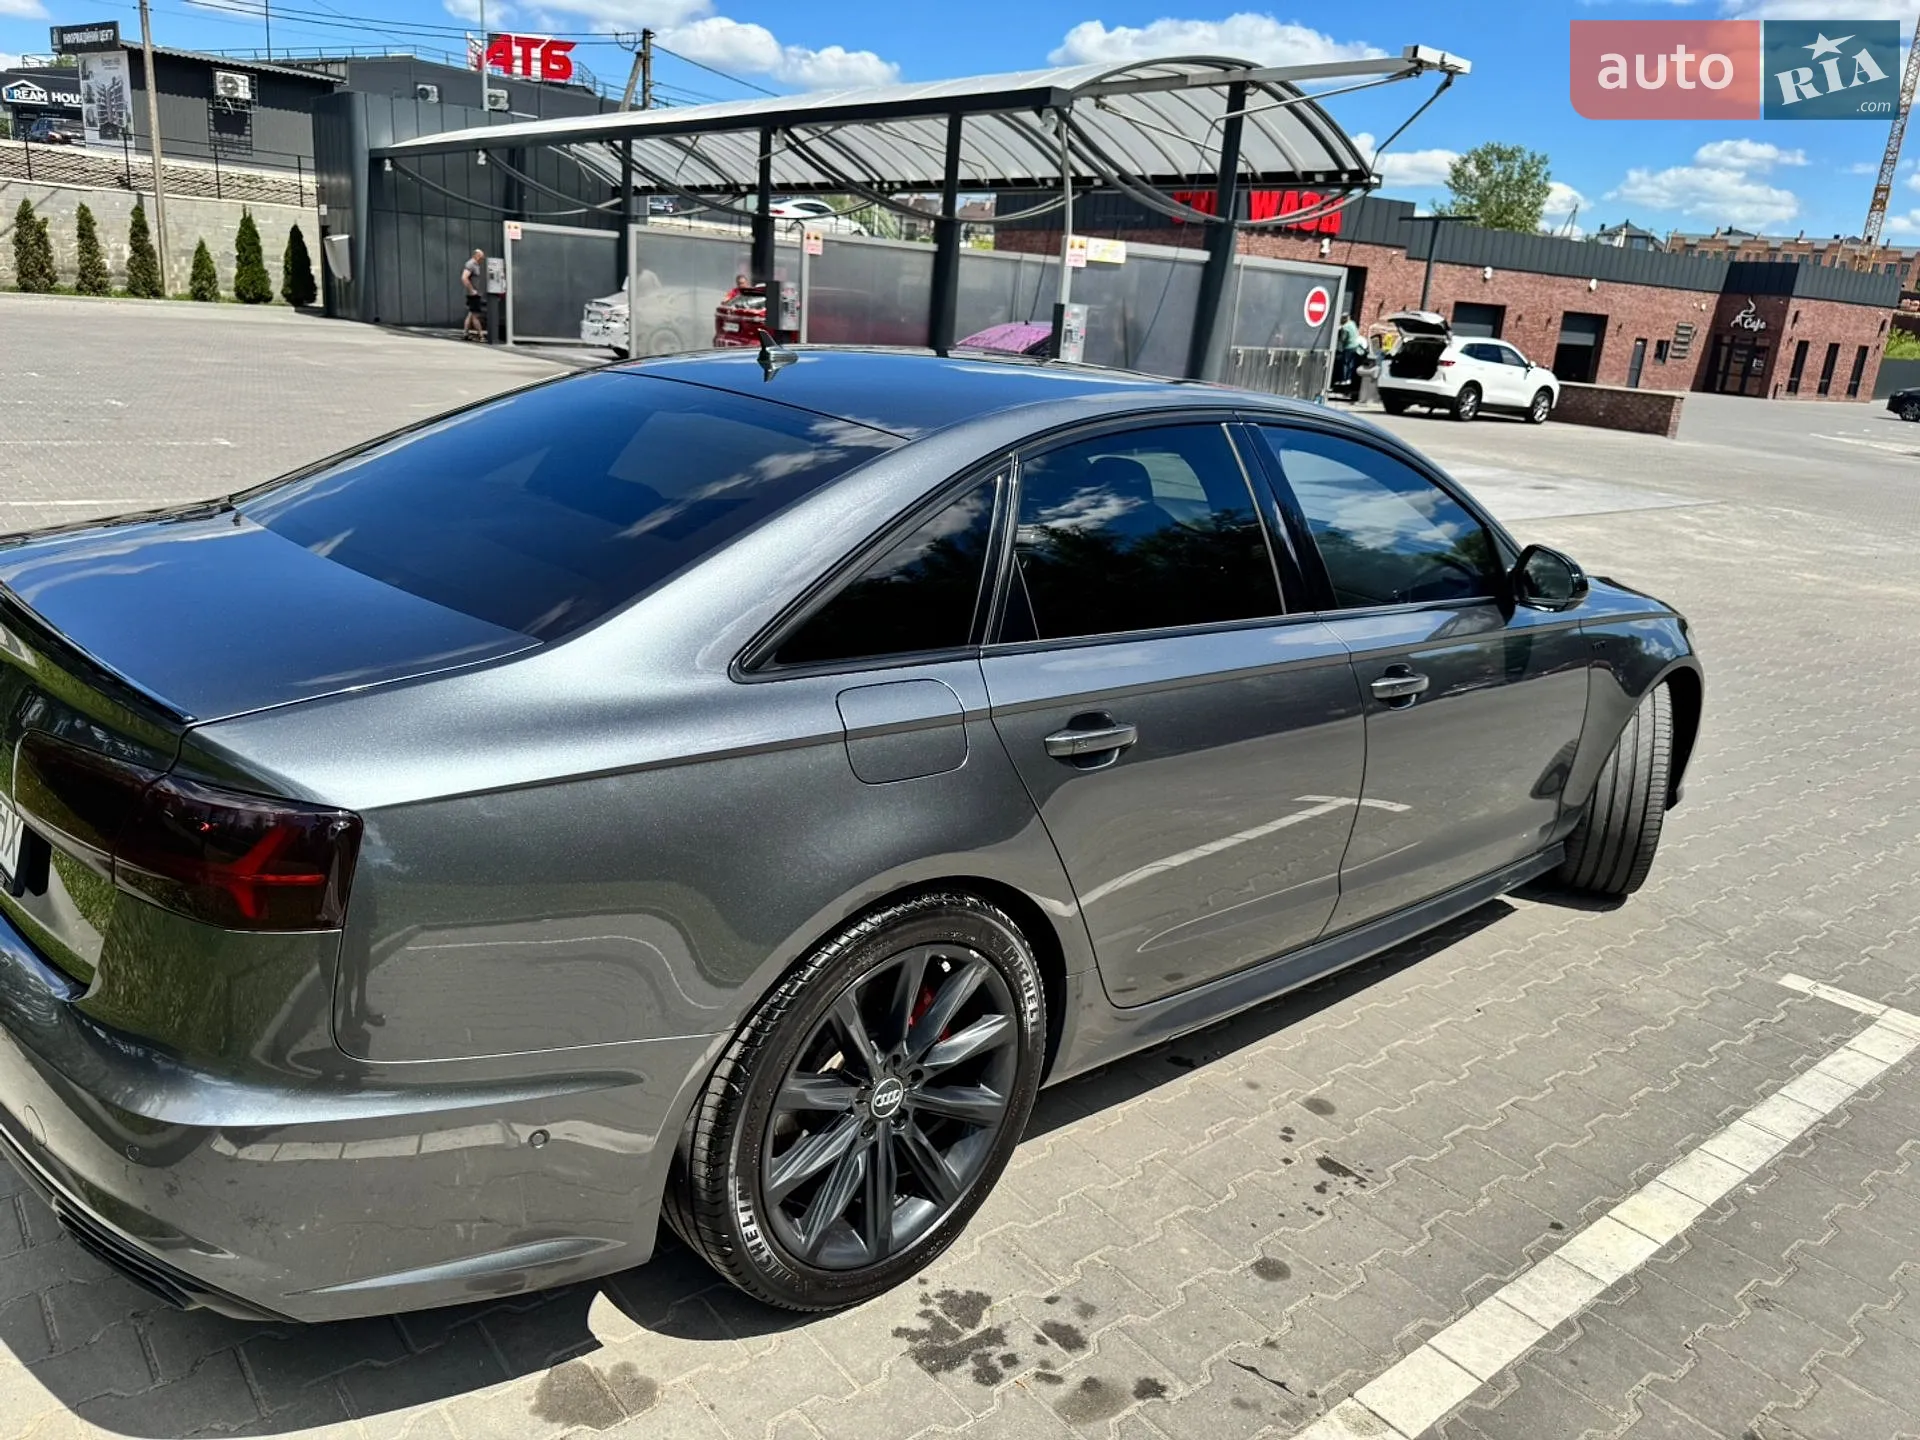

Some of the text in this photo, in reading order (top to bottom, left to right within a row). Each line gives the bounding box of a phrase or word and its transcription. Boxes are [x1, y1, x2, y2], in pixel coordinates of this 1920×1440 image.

[486, 34, 576, 80] АТБ
[7, 88, 82, 103] DREAM HOU
